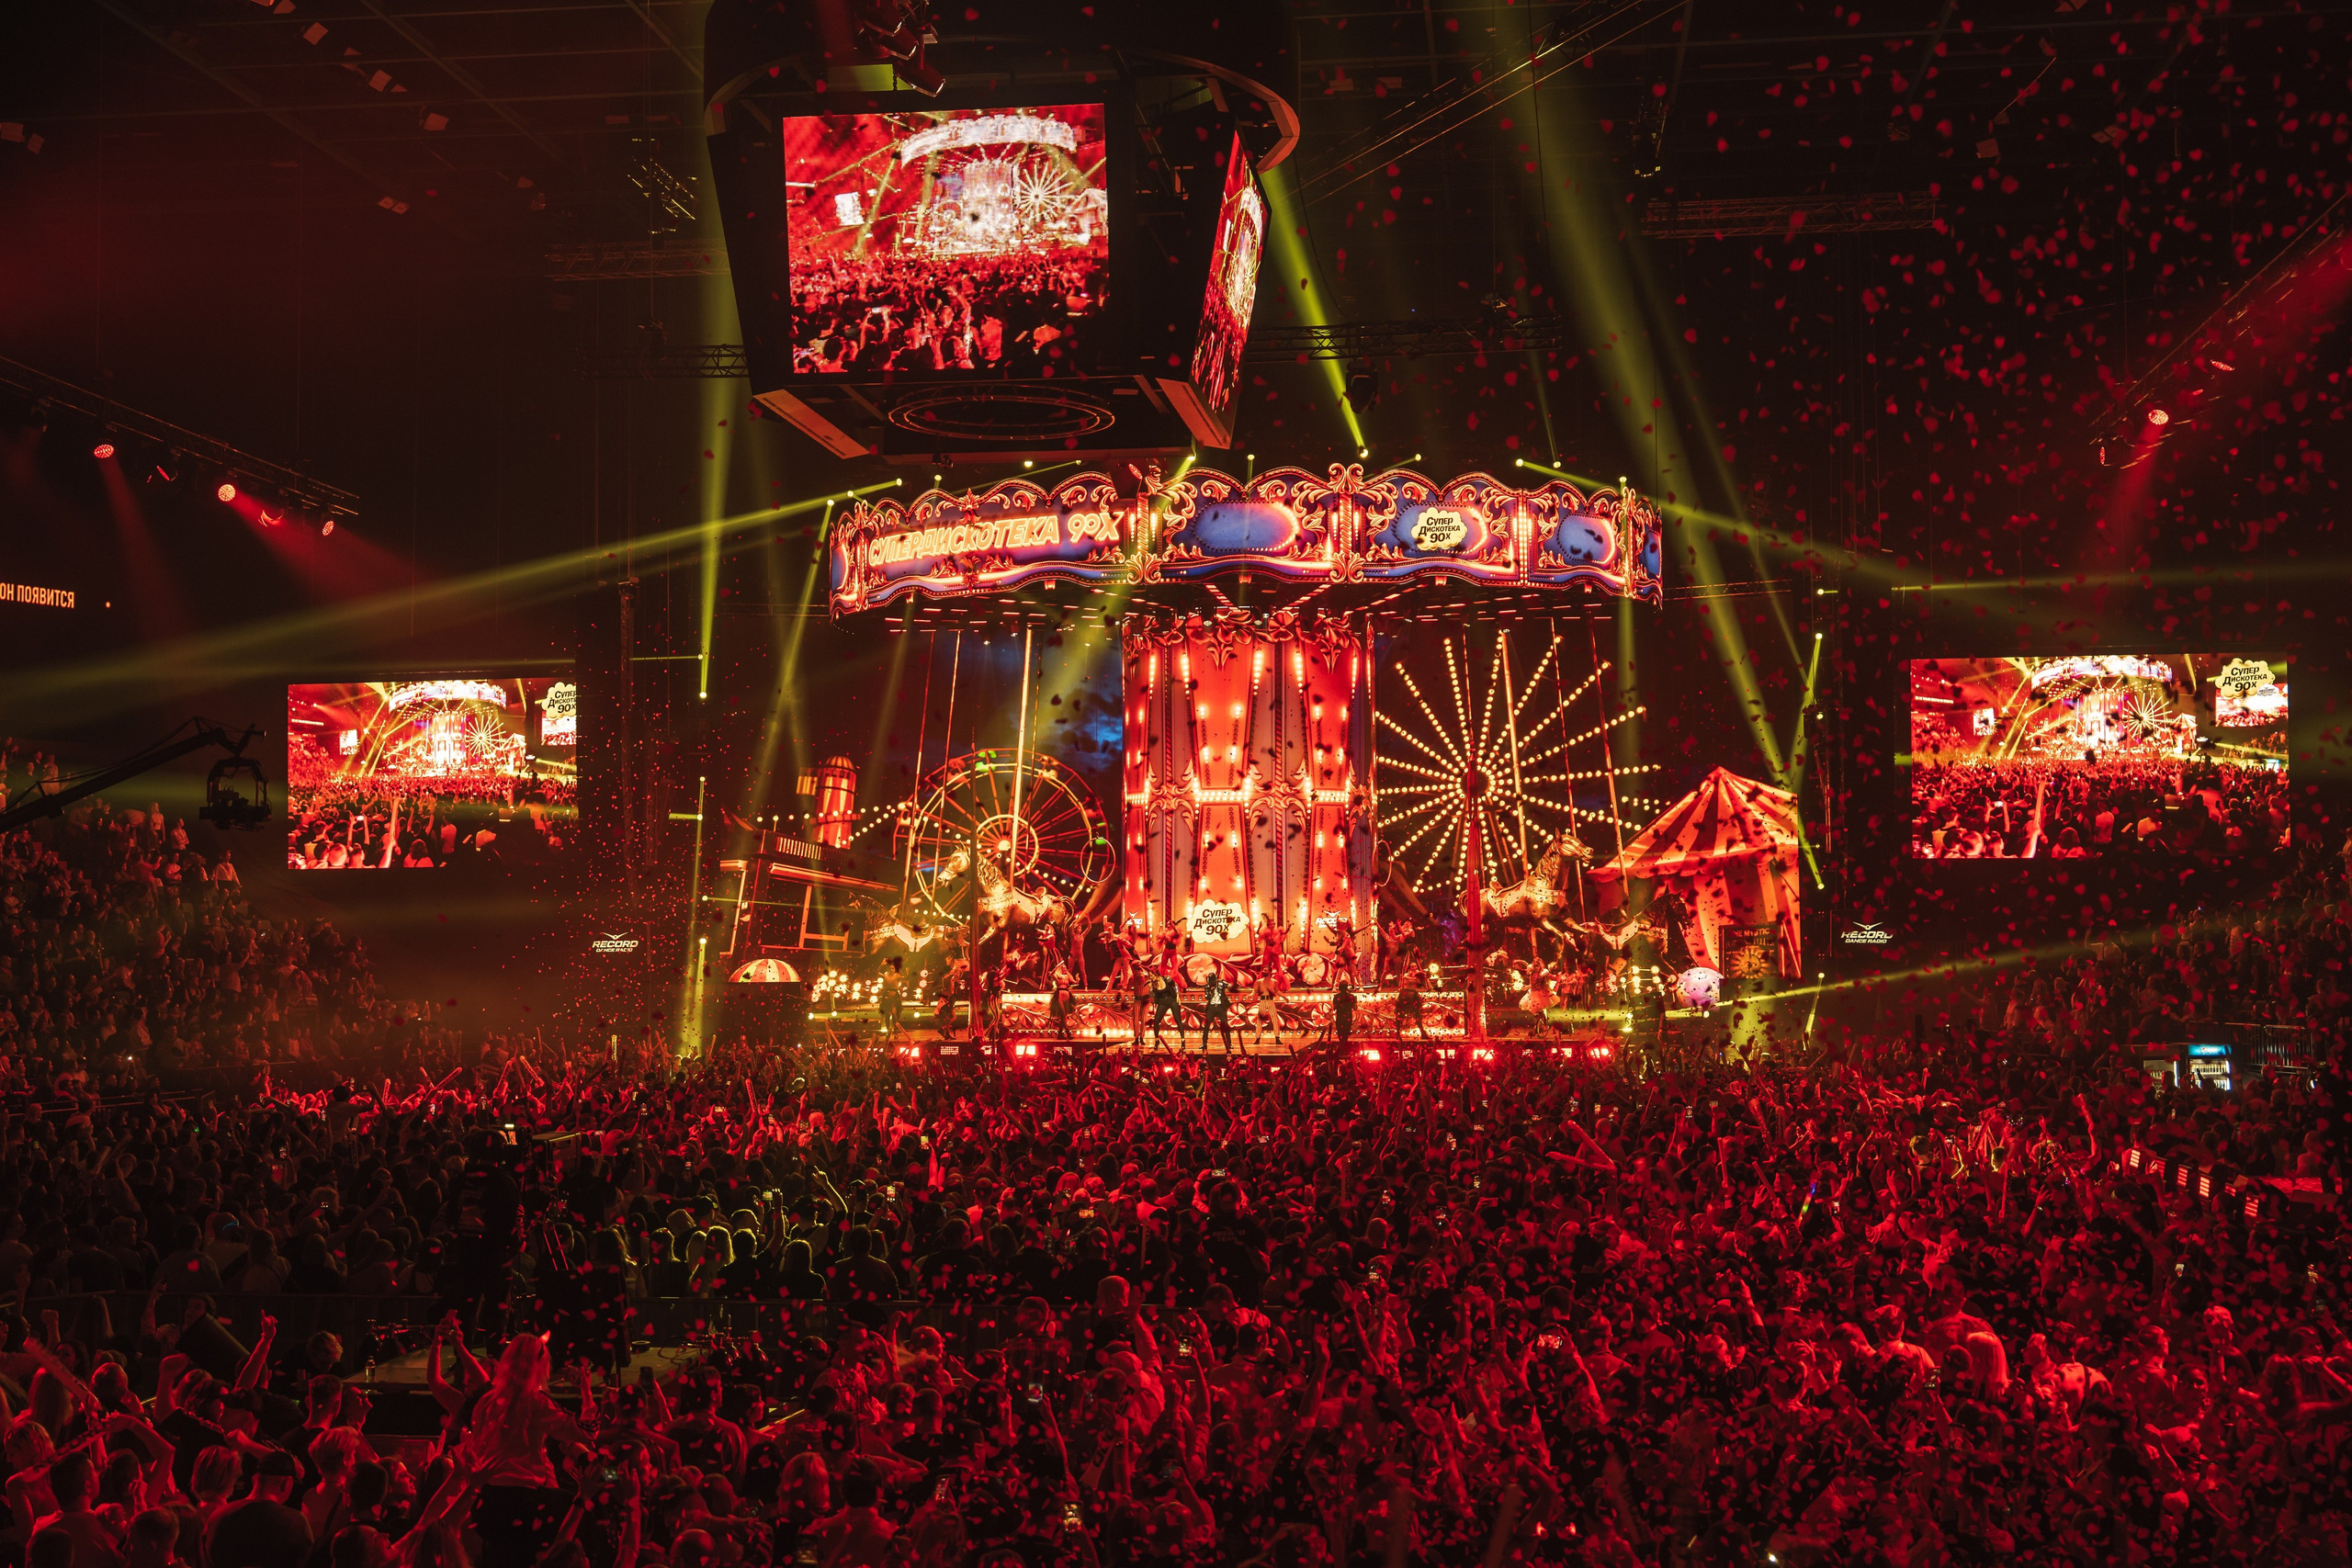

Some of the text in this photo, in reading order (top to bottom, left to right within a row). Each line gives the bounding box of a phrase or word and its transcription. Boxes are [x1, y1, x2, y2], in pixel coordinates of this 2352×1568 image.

[868, 515, 1060, 567] СУПЕРДИСКОТЕКА
[0, 582, 74, 608] ОН ПОЯВИТСЯ
[592, 940, 639, 948] RECORD
